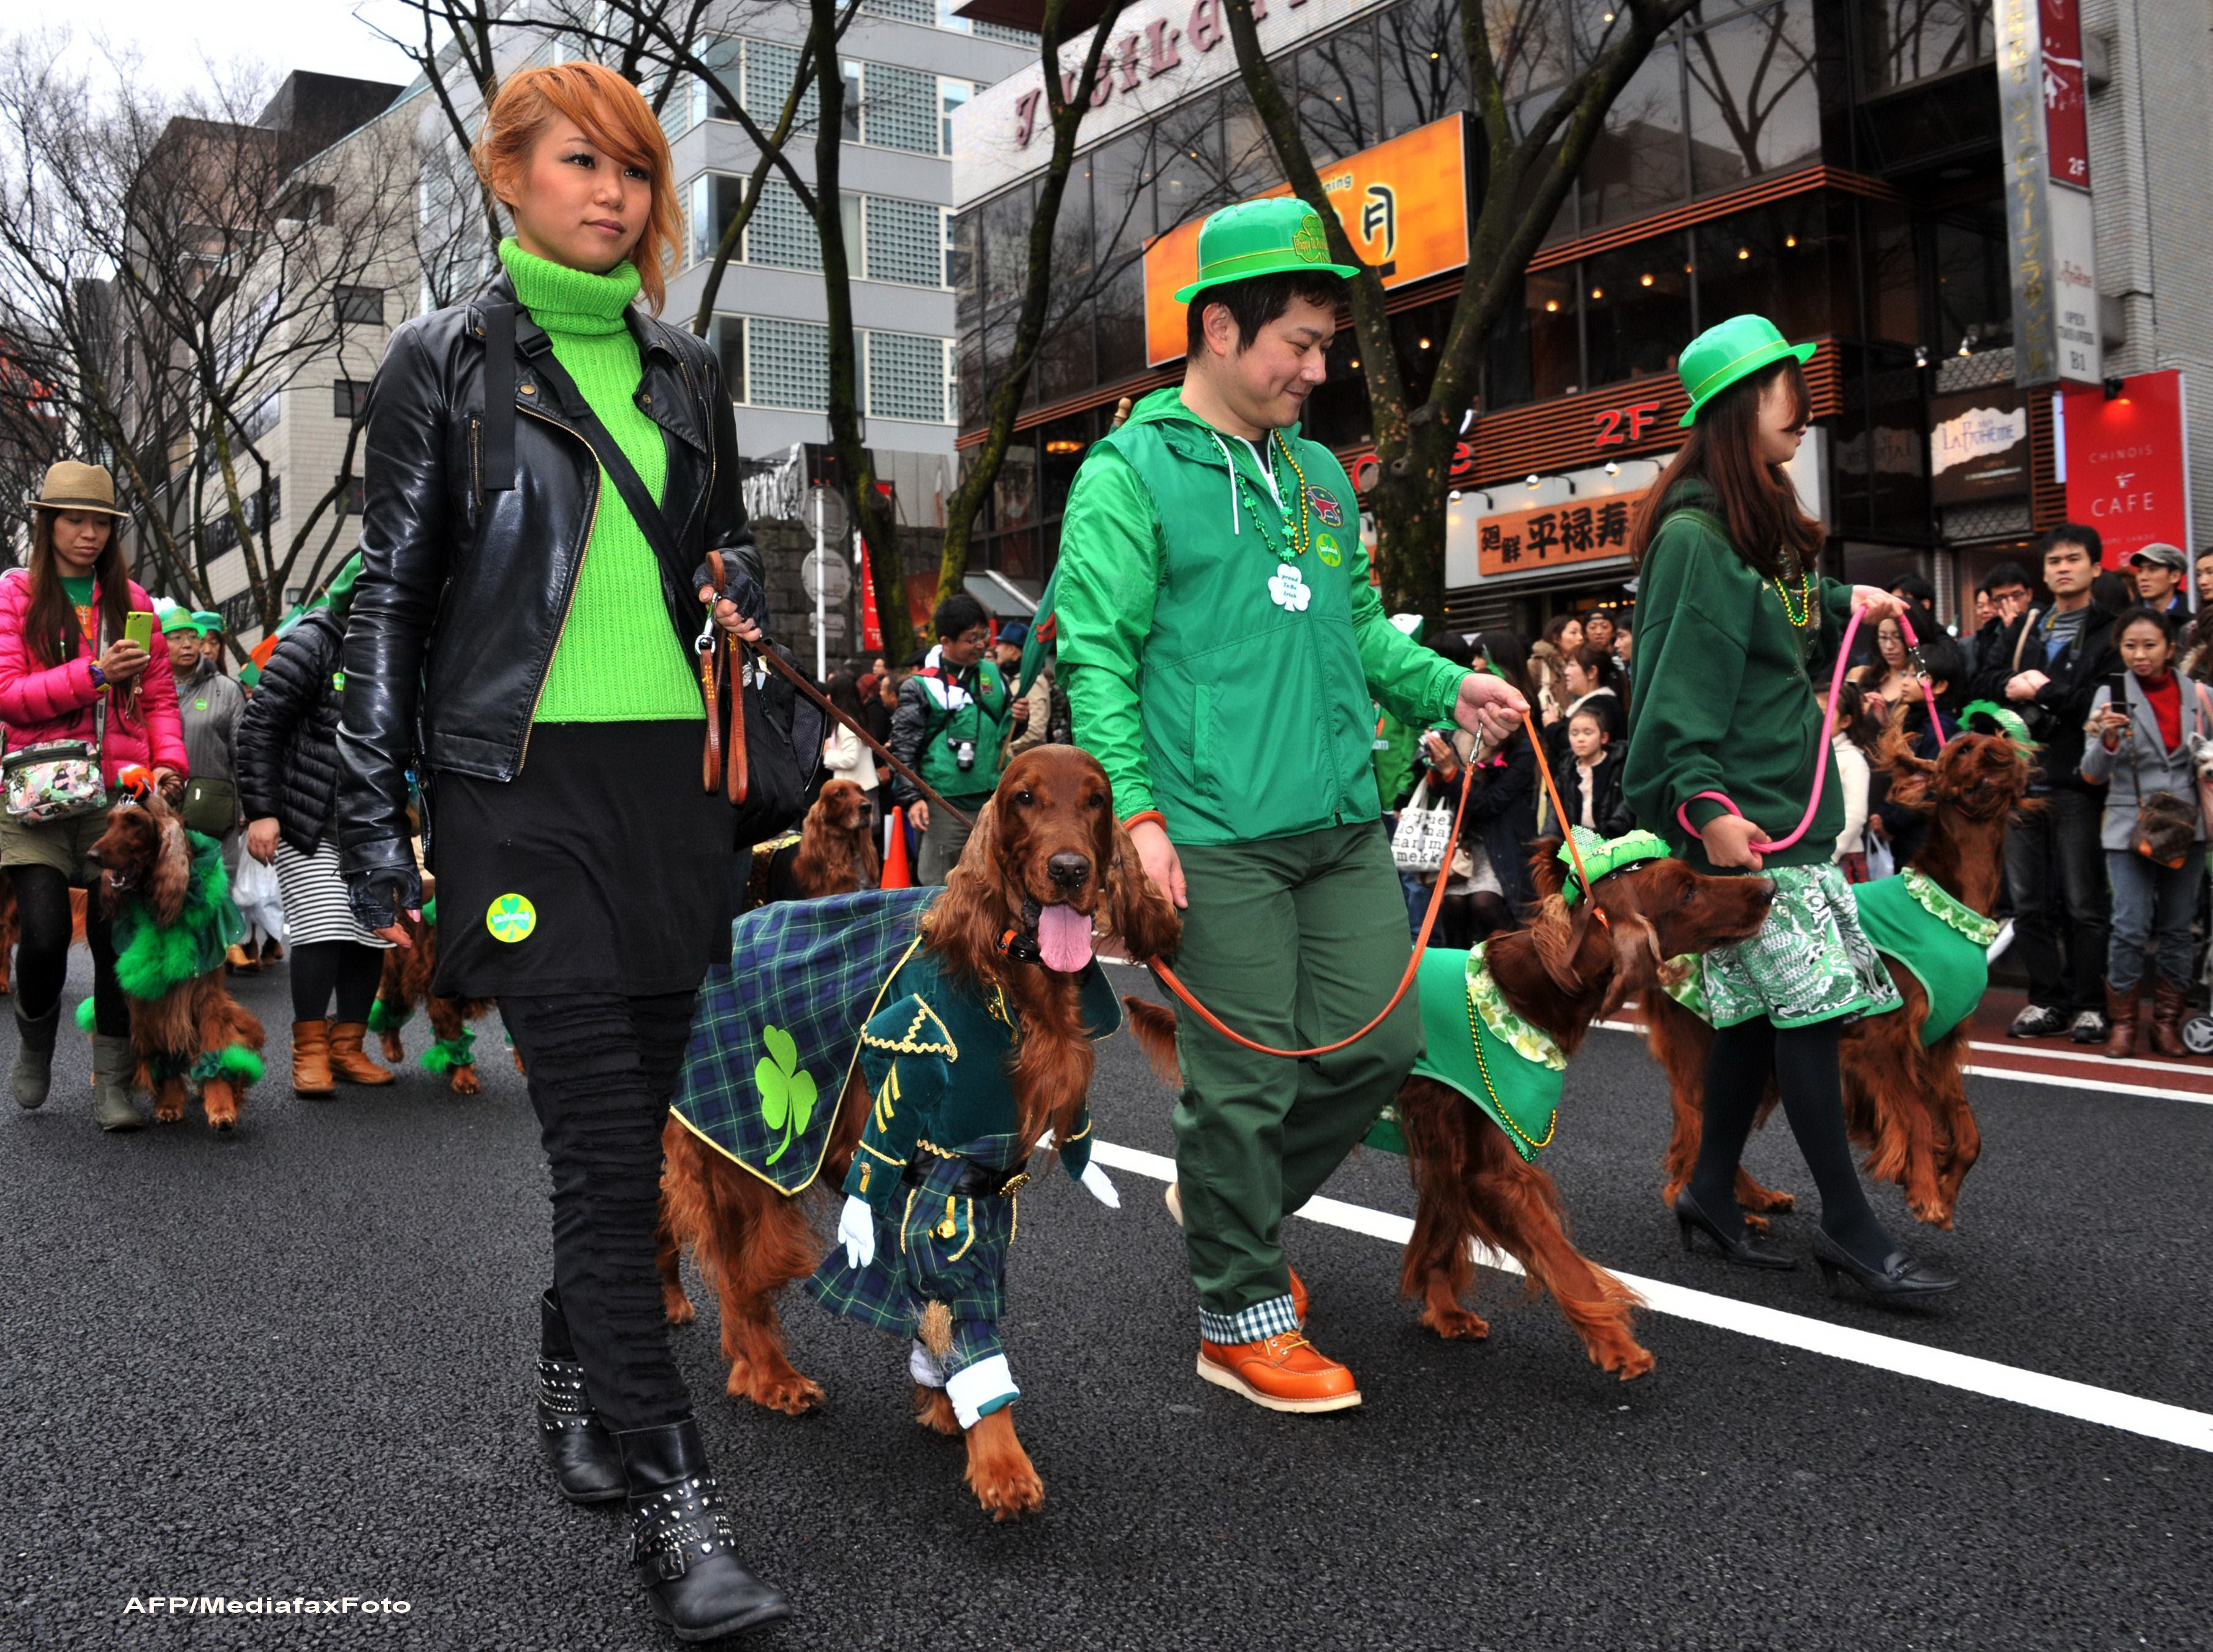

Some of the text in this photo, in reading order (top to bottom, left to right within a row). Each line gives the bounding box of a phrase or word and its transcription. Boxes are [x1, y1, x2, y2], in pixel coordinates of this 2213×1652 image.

[2068, 157, 2086, 176] 2F
[2070, 351, 2086, 371] B1
[1594, 402, 1660, 447] 2F
[2089, 444, 2154, 464] CHINOIS
[2091, 491, 2154, 518] CAFE
